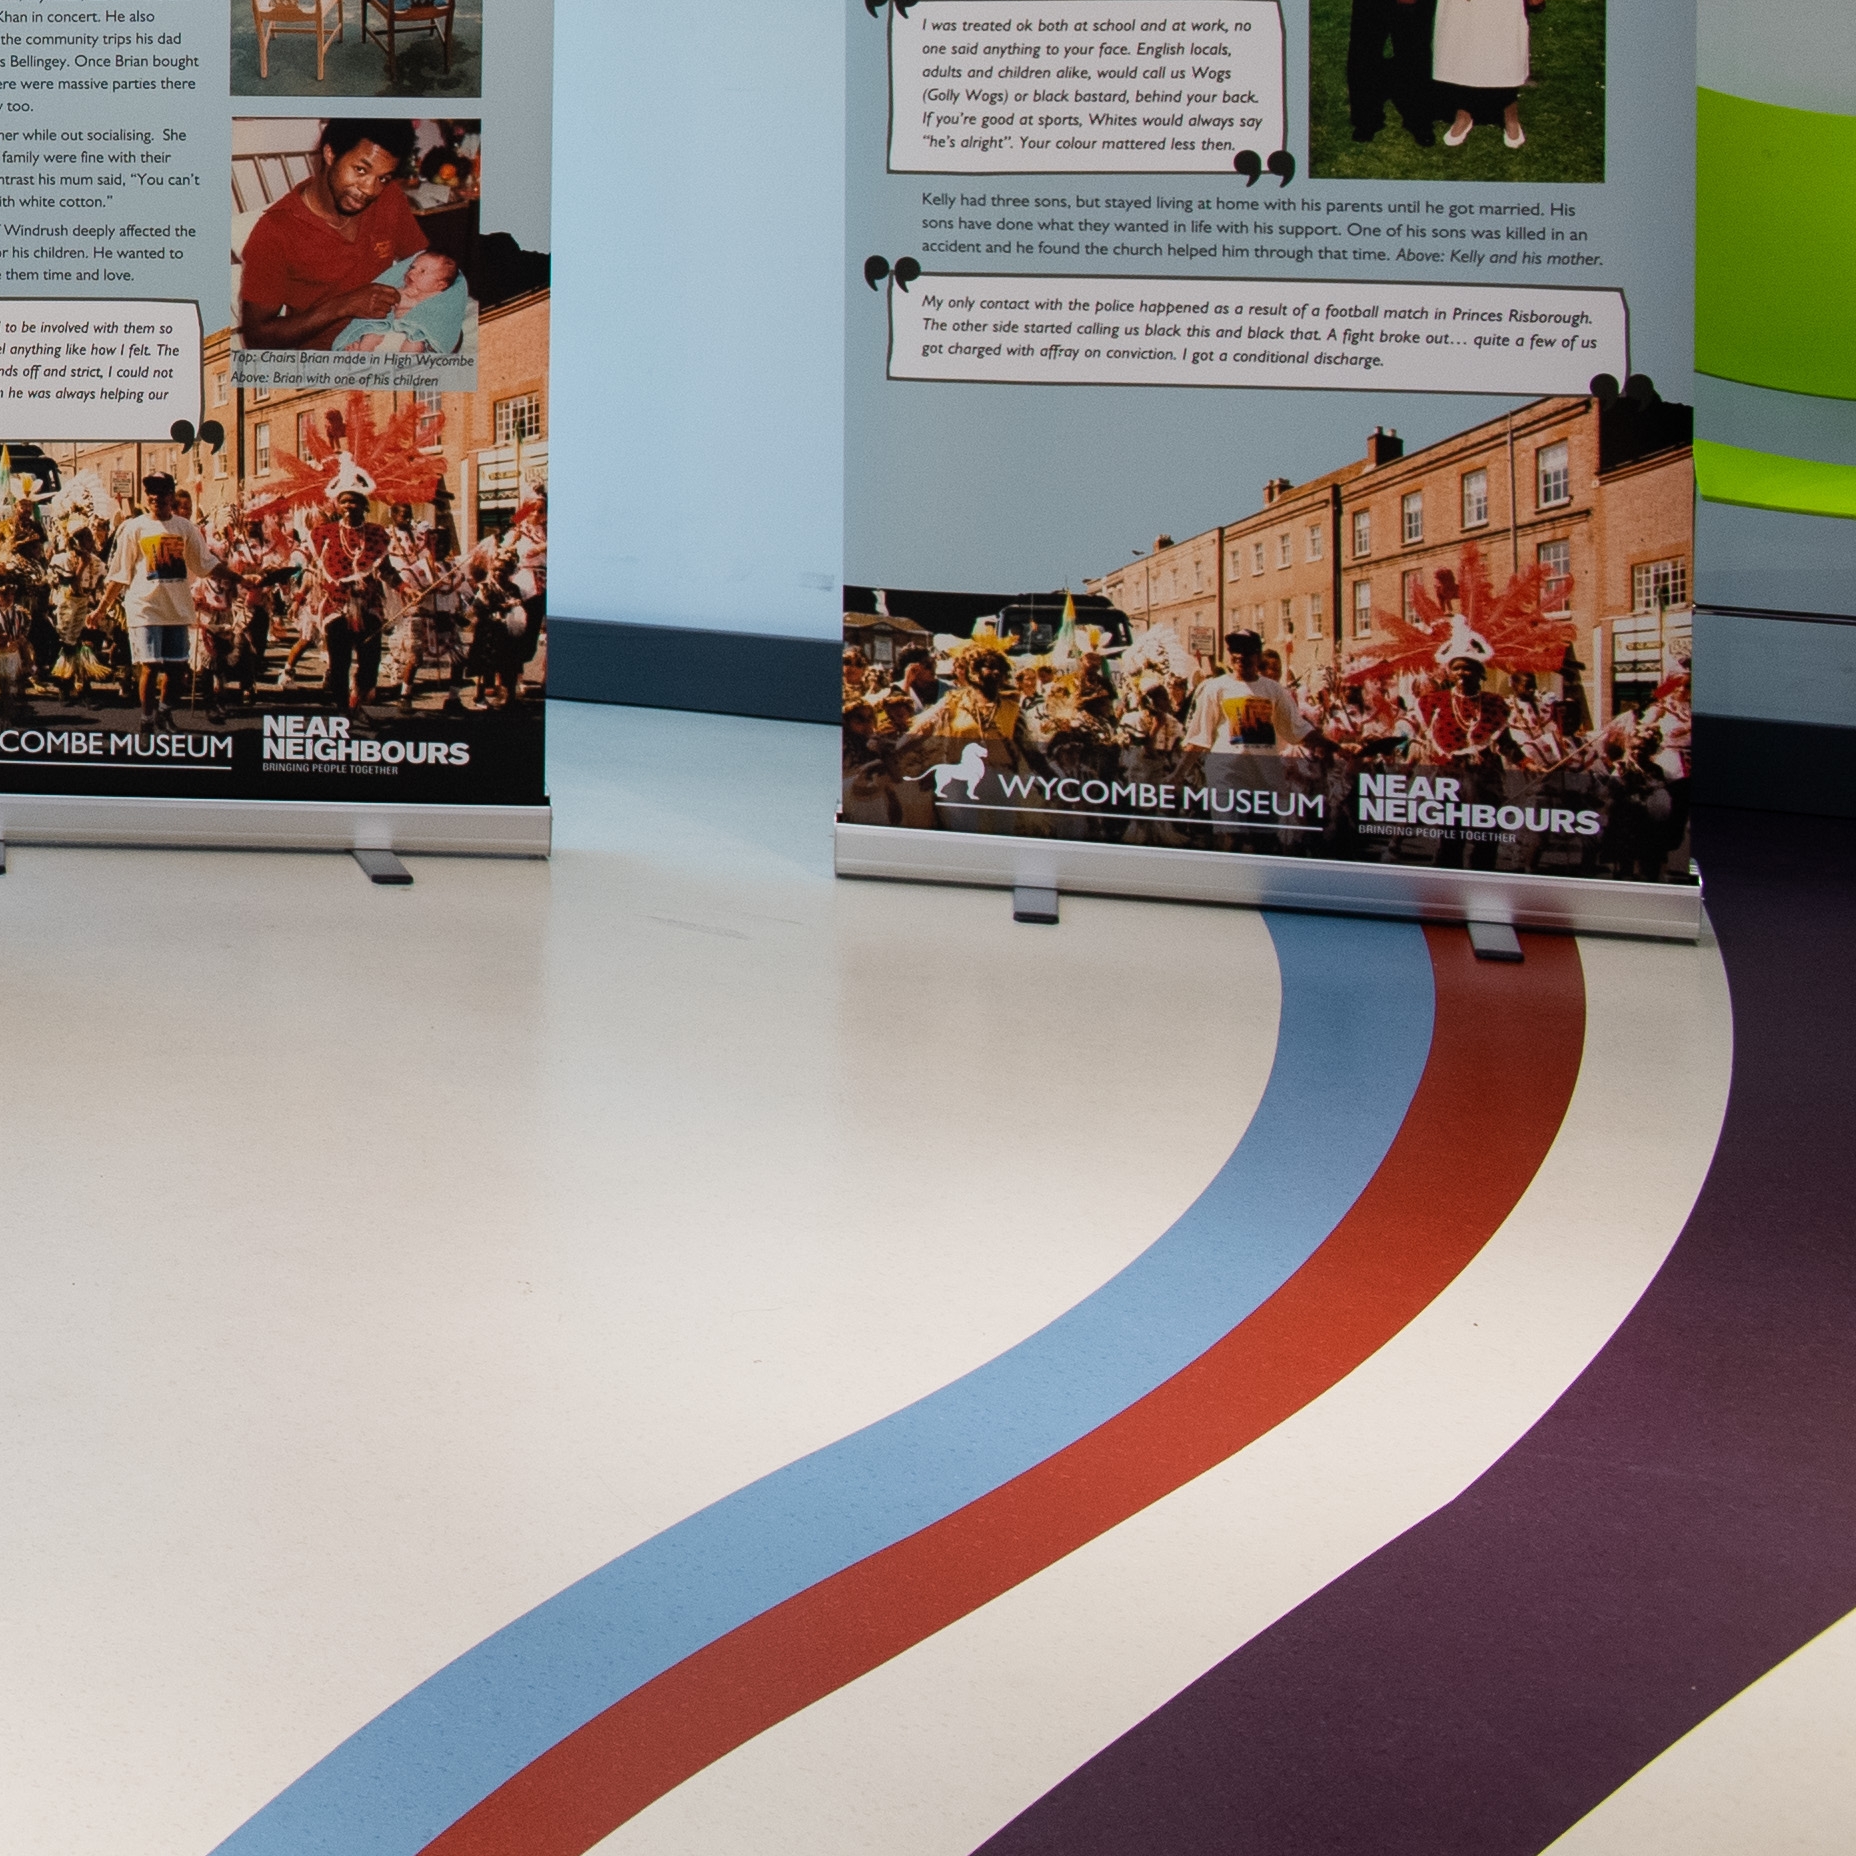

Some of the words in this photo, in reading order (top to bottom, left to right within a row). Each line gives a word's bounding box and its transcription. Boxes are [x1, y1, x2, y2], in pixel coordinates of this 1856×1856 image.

[263, 715, 350, 739] NEAR
[110, 733, 233, 758] MUSEUM
[263, 737, 470, 766] NEIGHBOURS
[262, 762, 310, 773] BRINGING
[311, 763, 347, 774] PEOPLE
[349, 764, 399, 775] TOGETHER
[998, 773, 1175, 809] WYCOMBE
[1183, 786, 1324, 818] MUSEUM
[1359, 772, 1460, 802] NEAR
[1358, 797, 1601, 835] NEIGHBOURS
[1358, 824, 1414, 837] BRINGING
[1415, 827, 1455, 839] PEOPLE
[1459, 830, 1519, 846] TOGETHER
